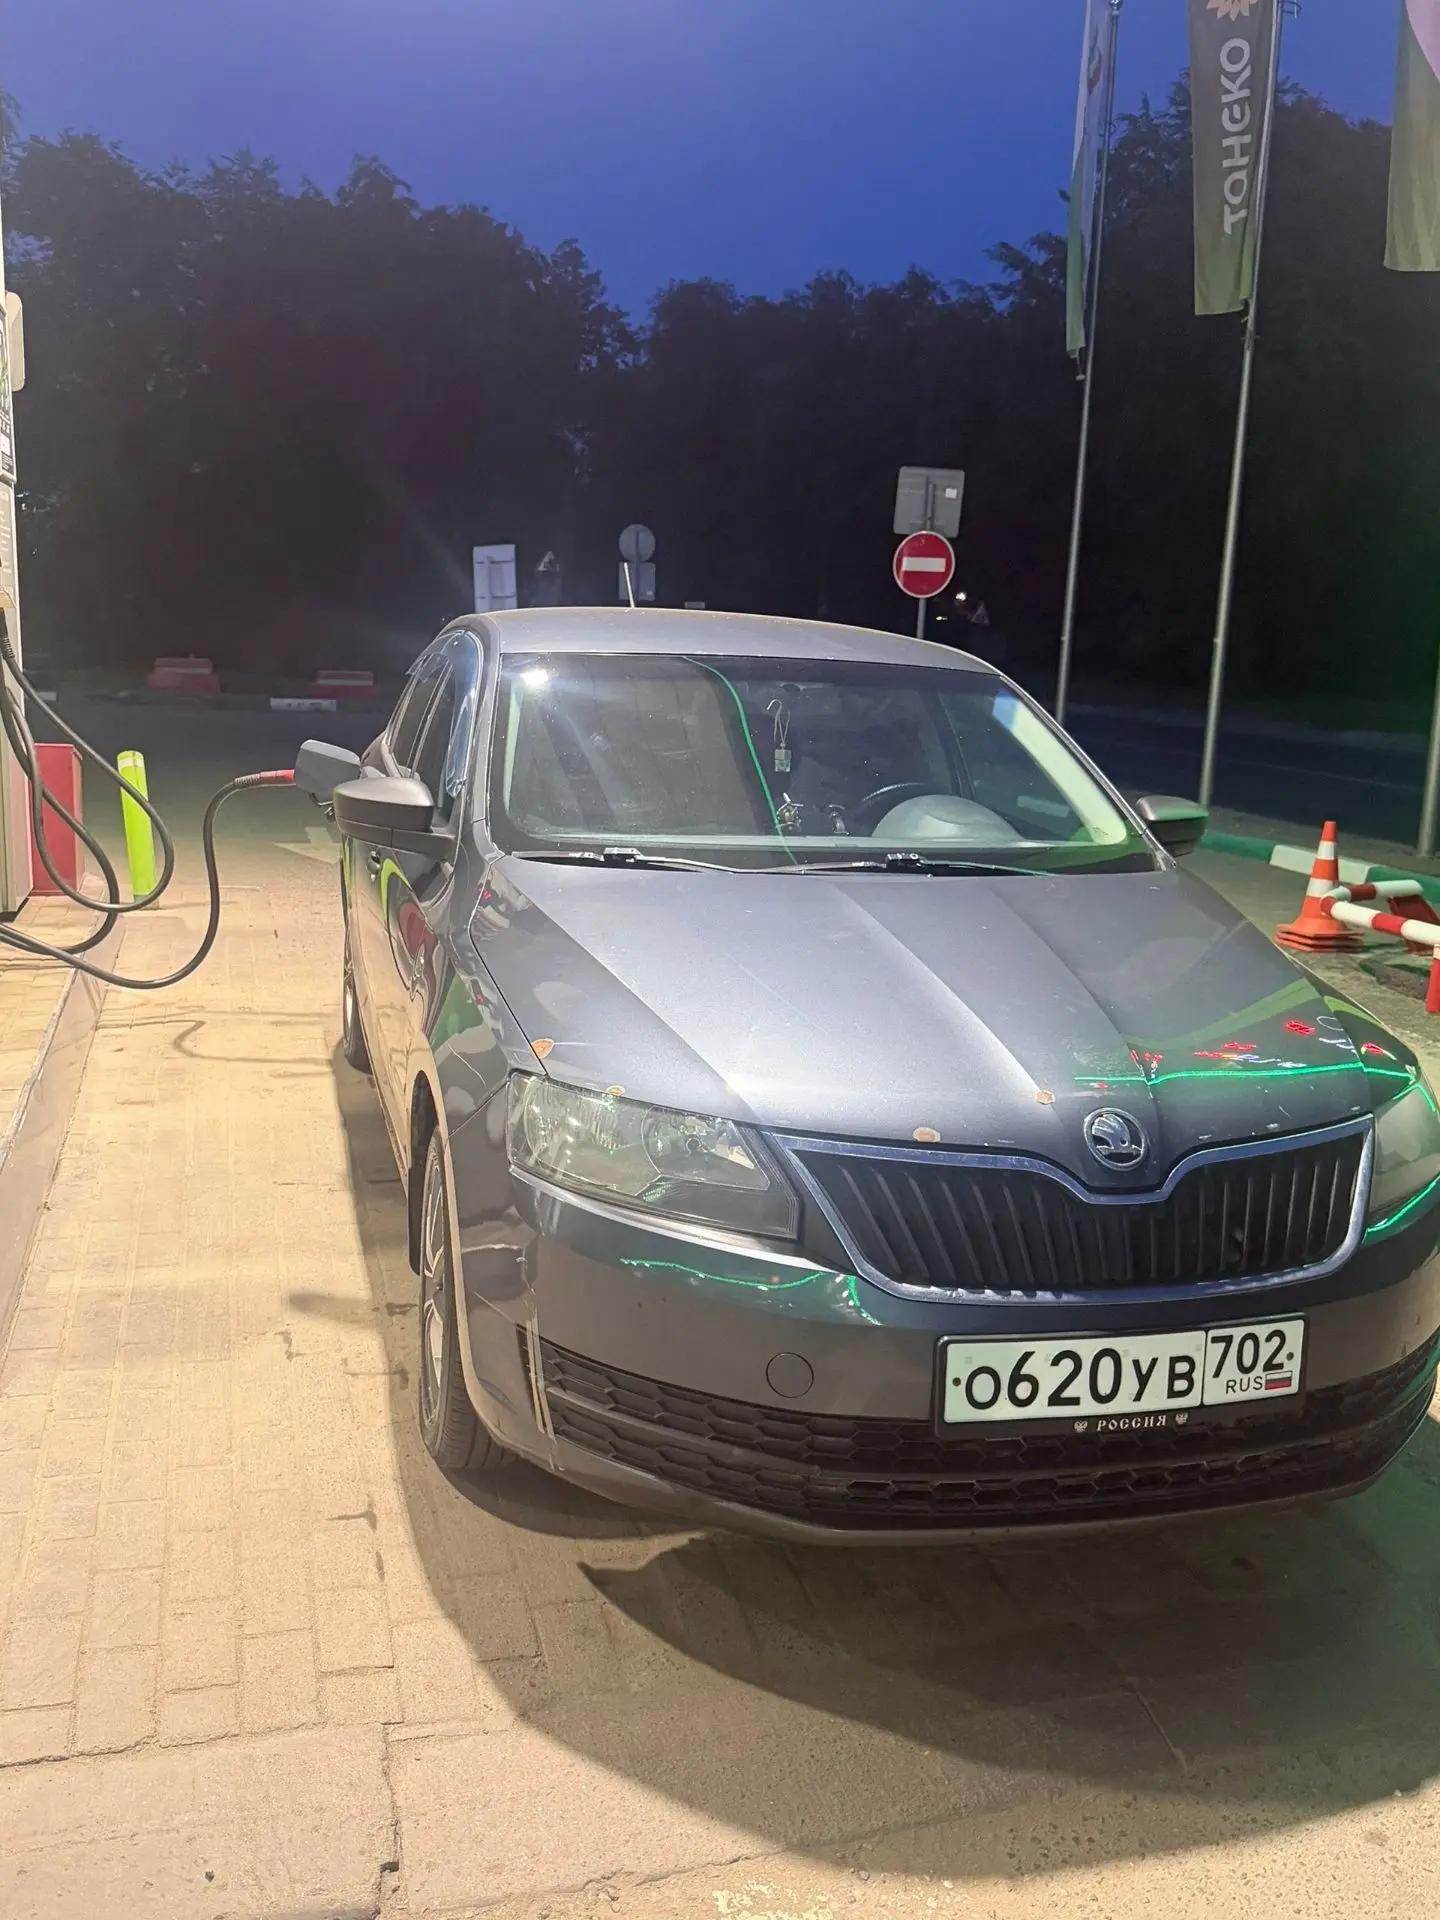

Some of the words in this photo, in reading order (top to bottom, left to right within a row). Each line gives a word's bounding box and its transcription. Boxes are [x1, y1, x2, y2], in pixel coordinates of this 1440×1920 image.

[1210, 1329, 1285, 1379] 702
[1225, 1375, 1263, 1395] RUS
[1096, 1414, 1168, 1433] РОССИЯ
